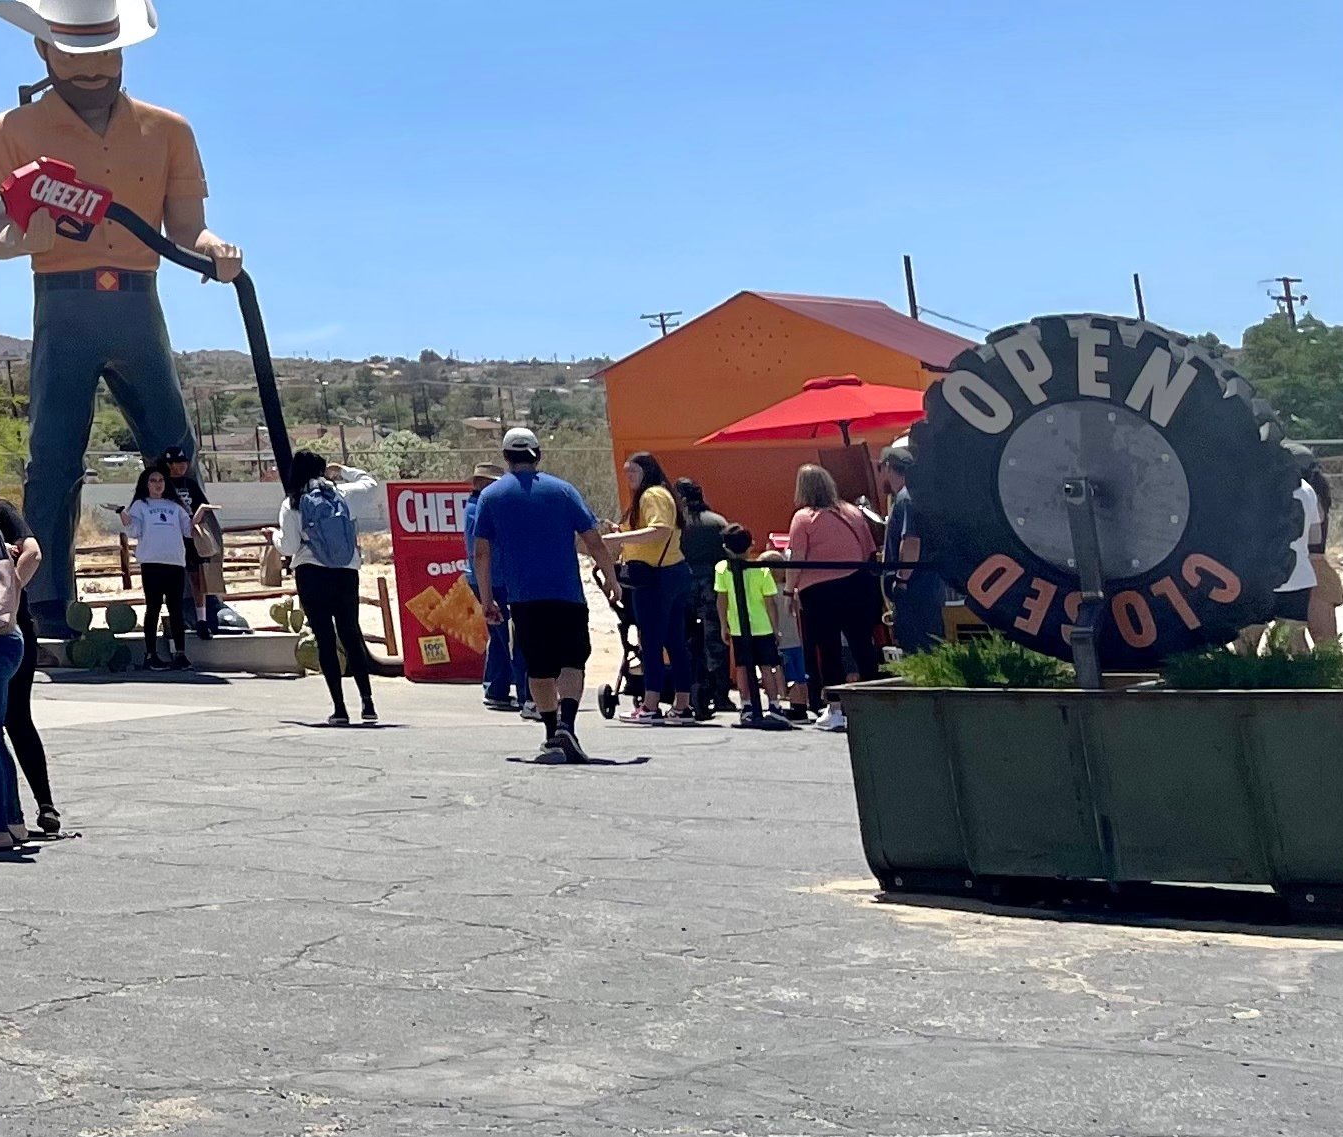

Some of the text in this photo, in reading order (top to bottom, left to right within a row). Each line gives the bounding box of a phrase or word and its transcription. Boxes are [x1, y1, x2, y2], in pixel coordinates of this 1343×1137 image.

[941, 325, 1199, 435] OPEN
[397, 489, 471, 533] CHEE
[427, 558, 470, 576] ORIG
